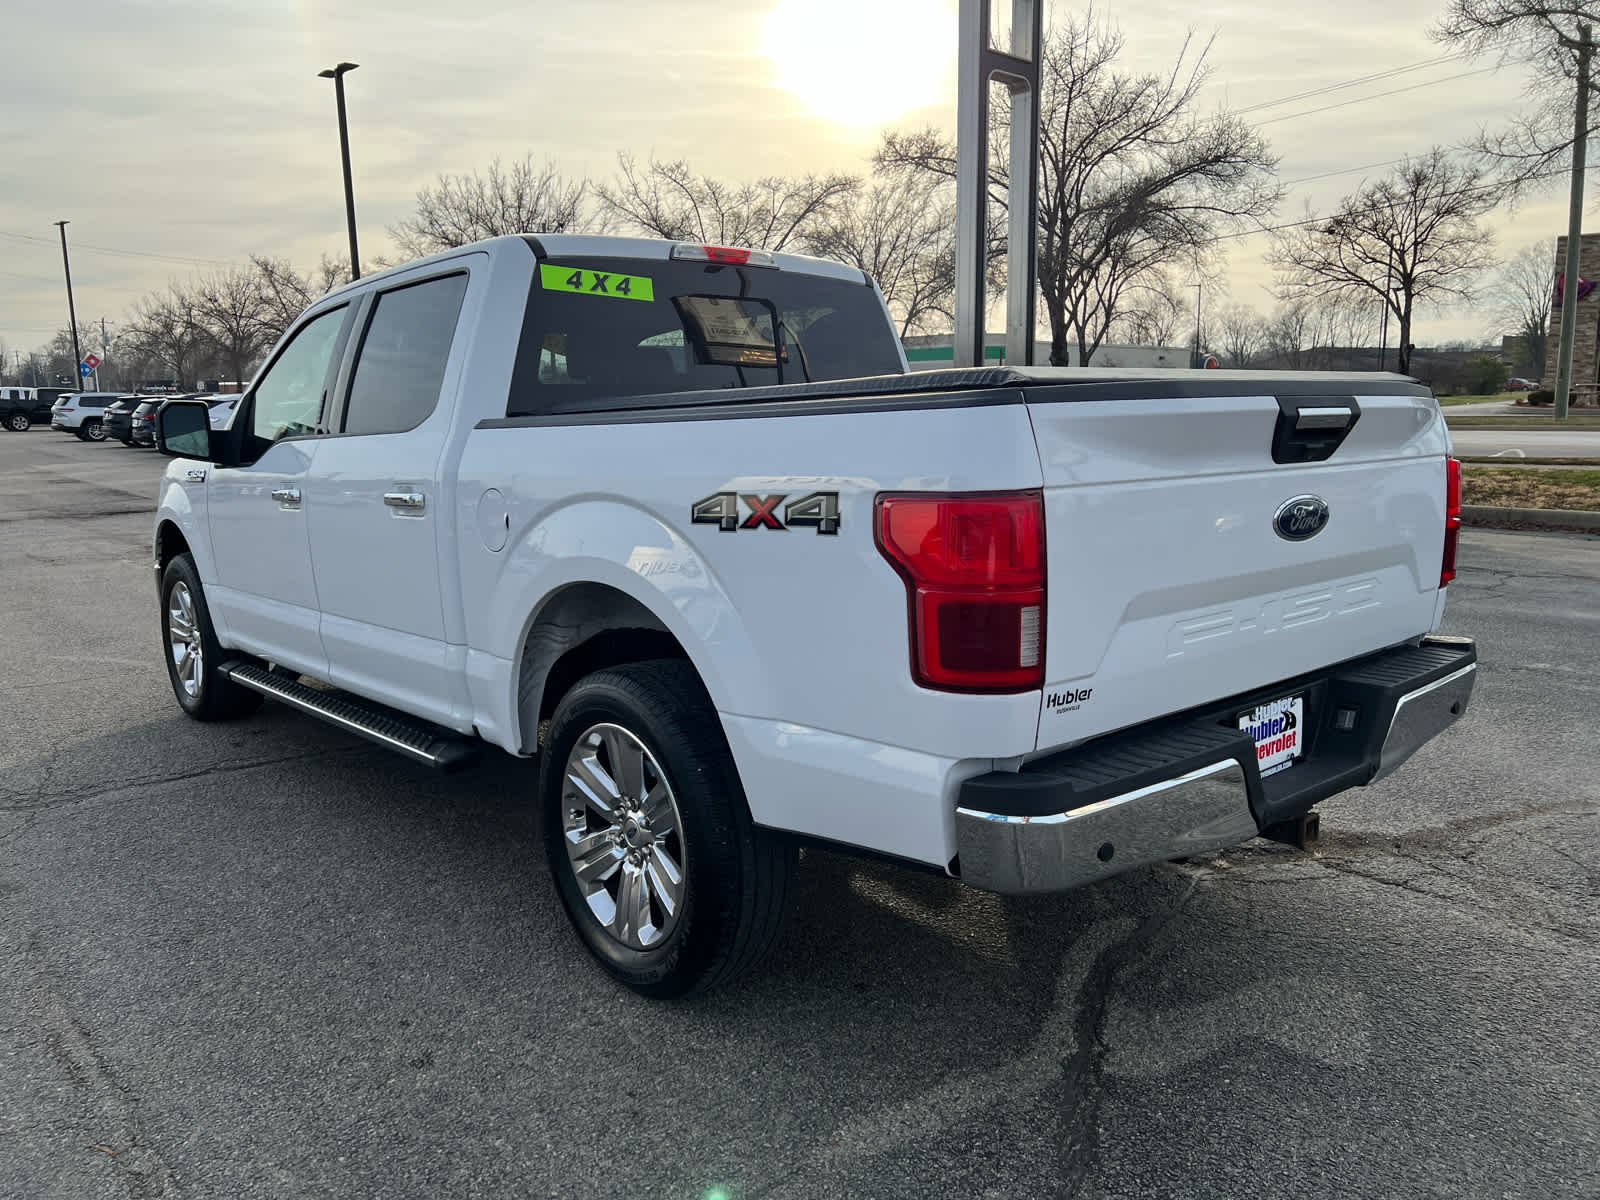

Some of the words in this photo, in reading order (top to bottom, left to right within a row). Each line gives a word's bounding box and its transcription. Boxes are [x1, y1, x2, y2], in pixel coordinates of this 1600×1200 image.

[691, 491, 841, 536] 4X4
[1289, 505, 1321, 531] Ford
[1046, 688, 1093, 709] Hubler
[1256, 730, 1297, 760] evrolet
